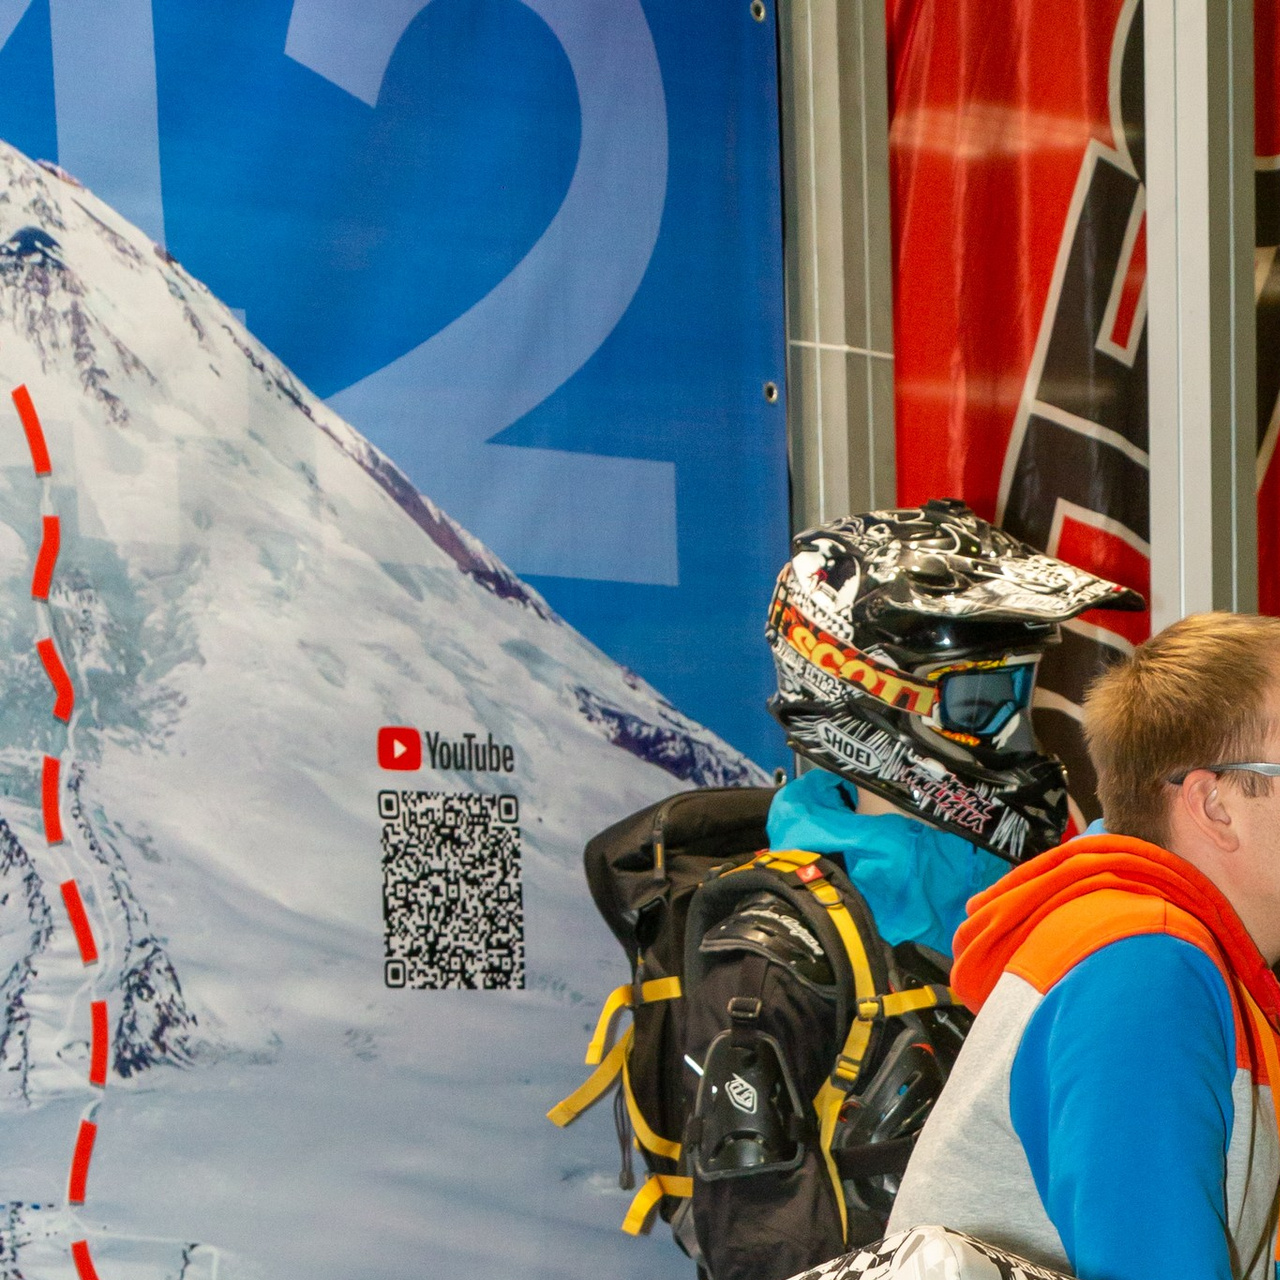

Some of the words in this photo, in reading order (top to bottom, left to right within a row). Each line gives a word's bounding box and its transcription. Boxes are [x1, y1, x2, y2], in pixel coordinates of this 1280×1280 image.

[788, 626, 935, 717] SCOTT
[425, 731, 514, 772] YouTube
[822, 722, 872, 767] SHOEI
